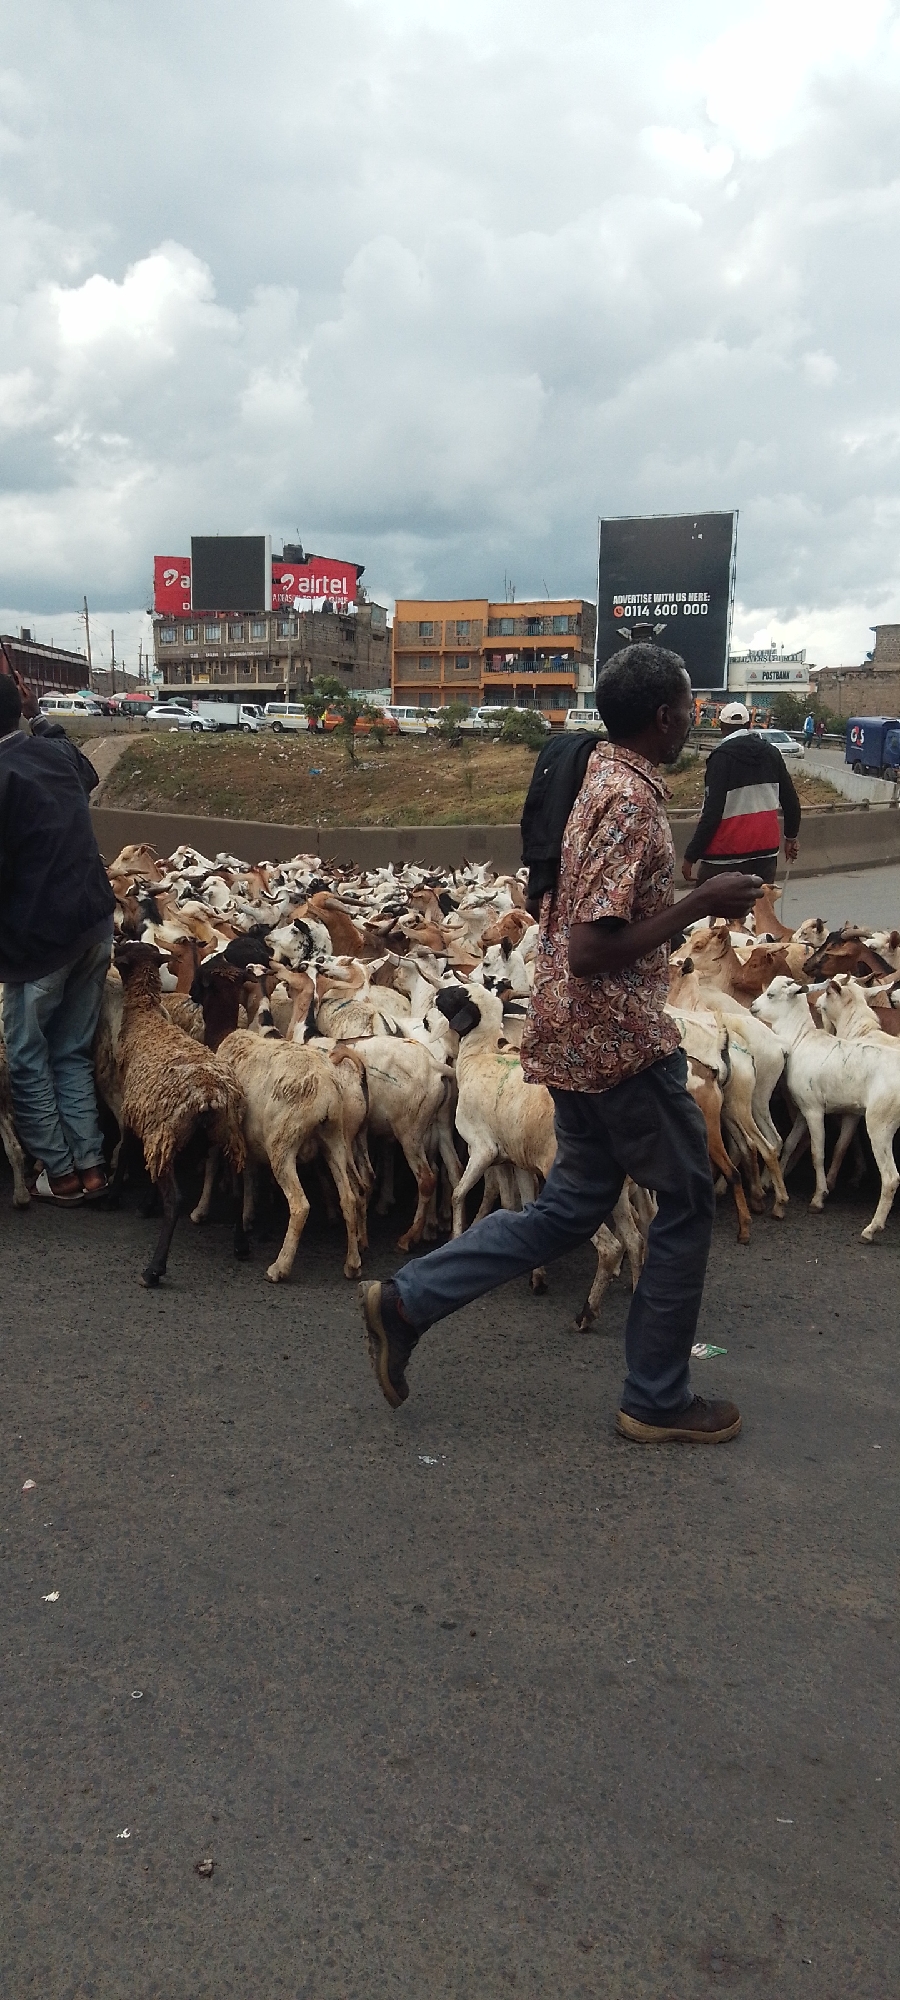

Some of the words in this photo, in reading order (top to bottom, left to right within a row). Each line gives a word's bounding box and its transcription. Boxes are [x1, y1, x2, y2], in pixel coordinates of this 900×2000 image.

[298, 574, 349, 595] airtel
[613, 593, 653, 605] ADVERTISE
[653, 593, 675, 603] WITH
[675, 592, 687, 602] US
[624, 604, 650, 617] 0114
[654, 604, 678, 616] 600
[683, 603, 709, 615] 000
[762, 671, 791, 680] POSTBANK
